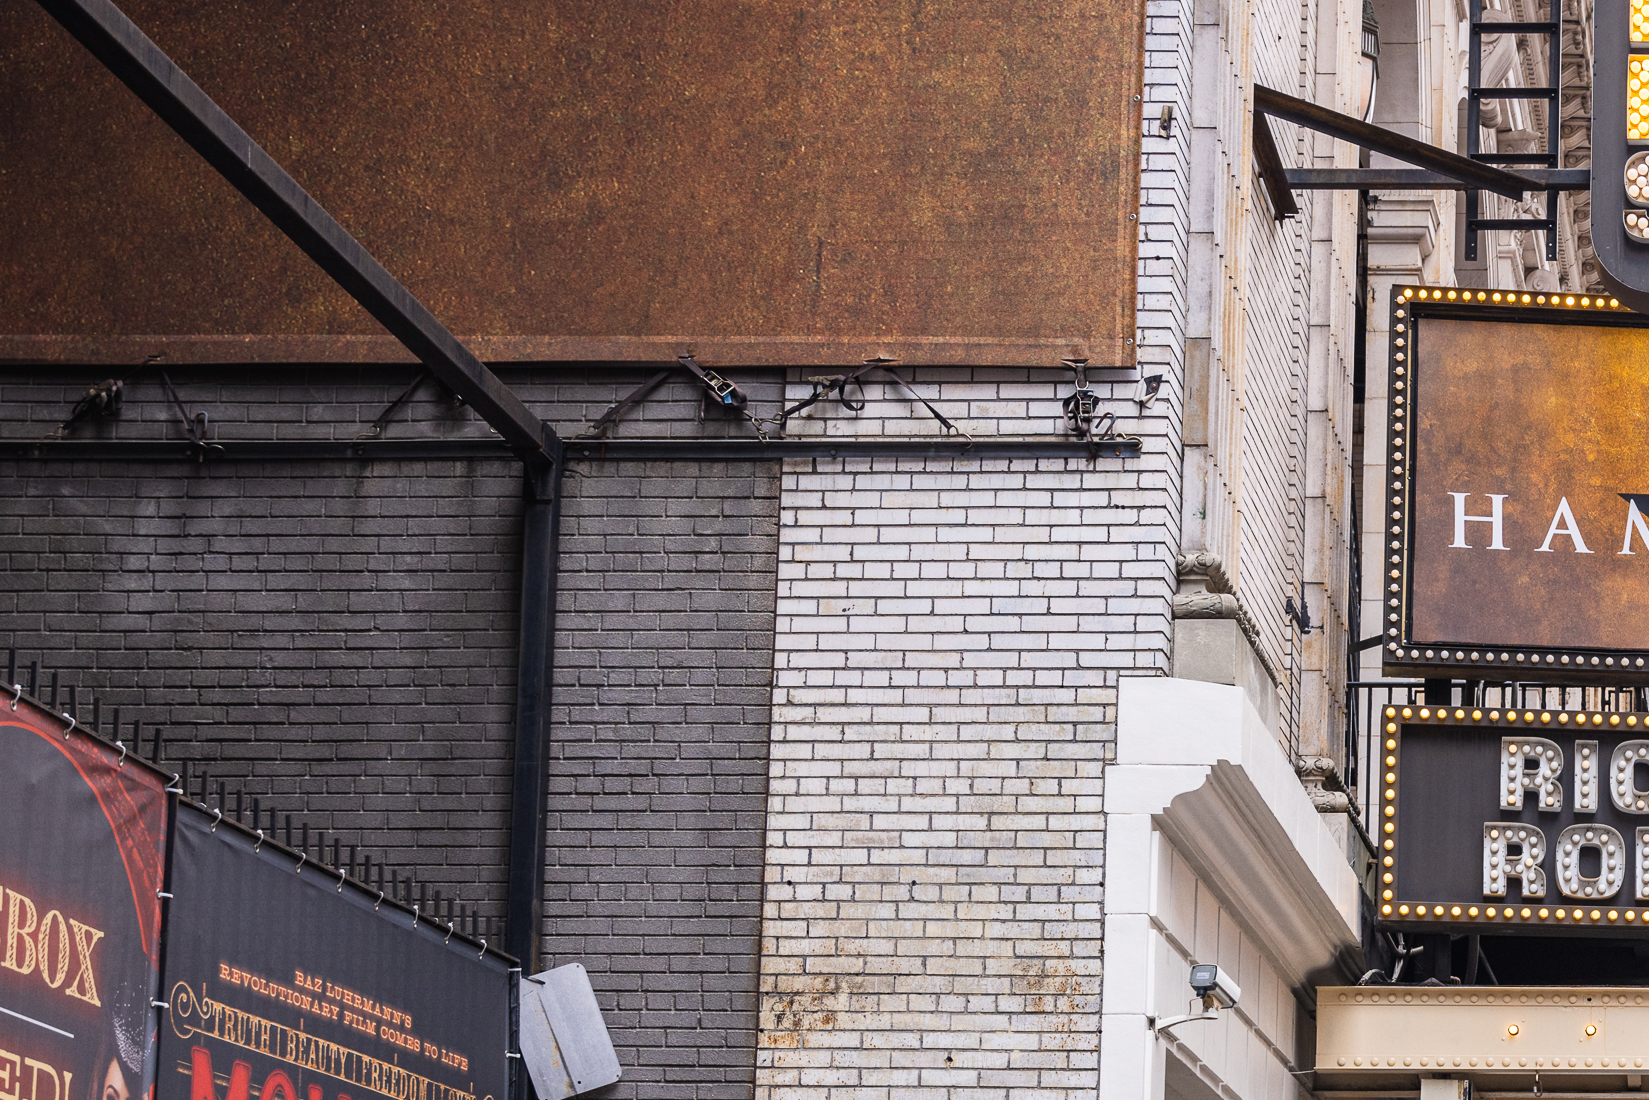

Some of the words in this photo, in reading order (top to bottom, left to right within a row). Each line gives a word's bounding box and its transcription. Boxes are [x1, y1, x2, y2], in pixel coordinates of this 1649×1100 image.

[0, 886, 104, 1007] BOX
[213, 1002, 271, 1054] TRUTH
[286, 1028, 348, 1079] BEAUTY
[220, 963, 339, 1019] REVOLUTIONARY
[343, 1010, 377, 1035] FILM
[380, 1026, 420, 1051] COMES
[424, 1042, 438, 1058] TO
[441, 1049, 469, 1070] LIFE
[295, 970, 322, 992] BAZ
[326, 982, 412, 1028] LUHRMANN'S
